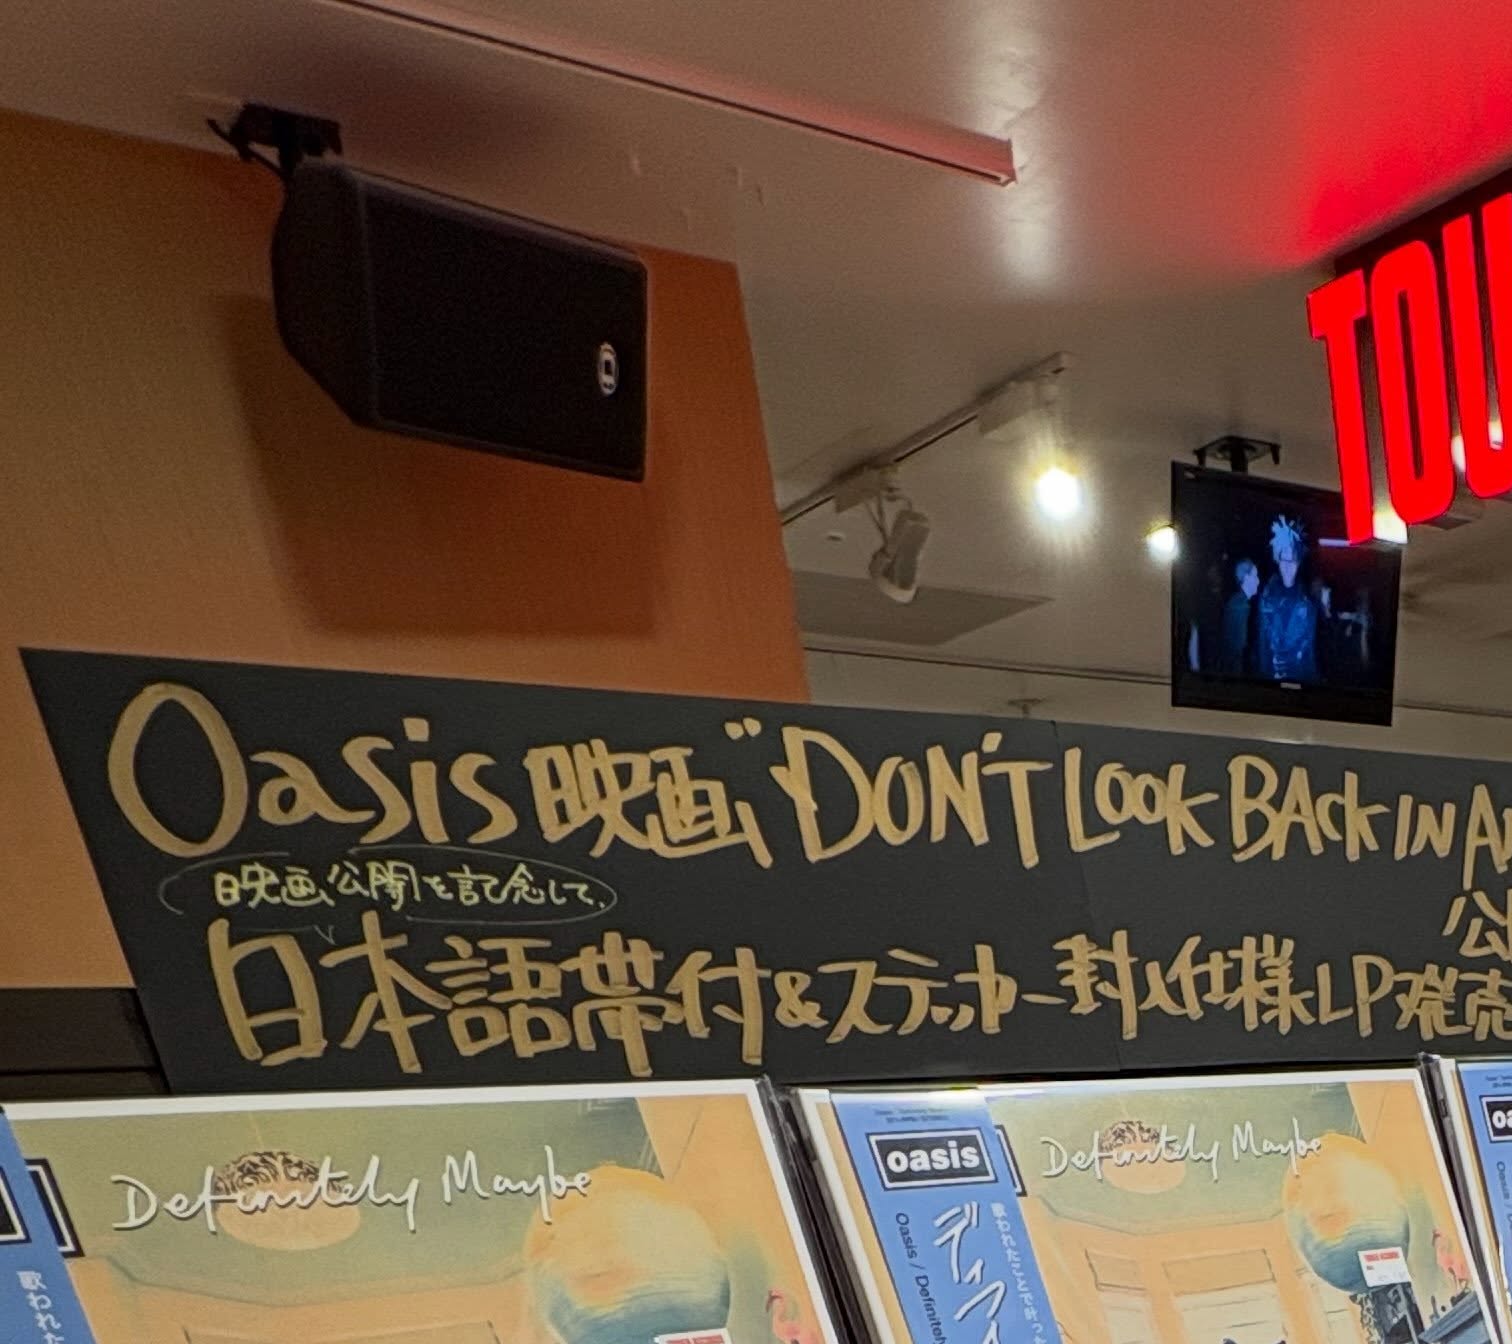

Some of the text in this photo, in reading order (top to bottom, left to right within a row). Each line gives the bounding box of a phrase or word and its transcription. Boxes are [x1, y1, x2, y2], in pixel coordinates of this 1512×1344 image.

[107, 682, 518, 857] Oasis
[1395, 794, 1461, 861] IN
[887, 1140, 980, 1173] oasis
[1040, 1117, 1322, 1183] Definitely Maybe
[112, 1146, 593, 1234] Definitely Maybe
[896, 1211, 918, 1260] Oasis
